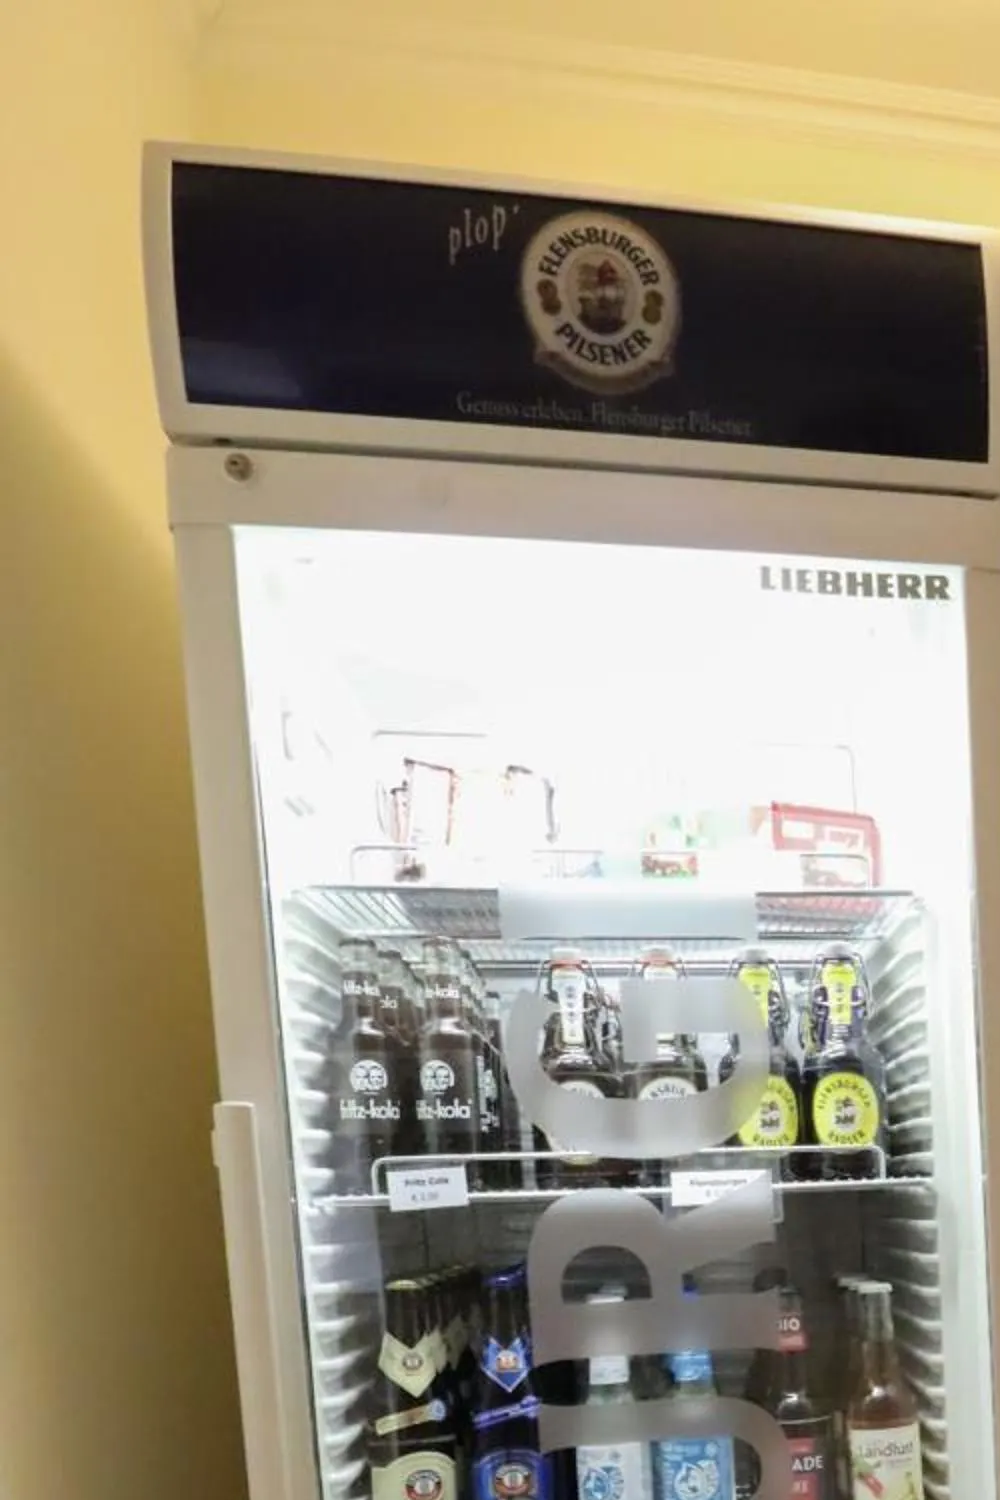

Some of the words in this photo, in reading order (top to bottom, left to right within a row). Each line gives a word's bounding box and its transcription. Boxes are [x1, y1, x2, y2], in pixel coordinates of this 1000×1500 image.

[538, 226, 661, 286] FLENSBURGER
[555, 321, 652, 366] PILSENER
[760, 565, 951, 601] LIEBHERR
